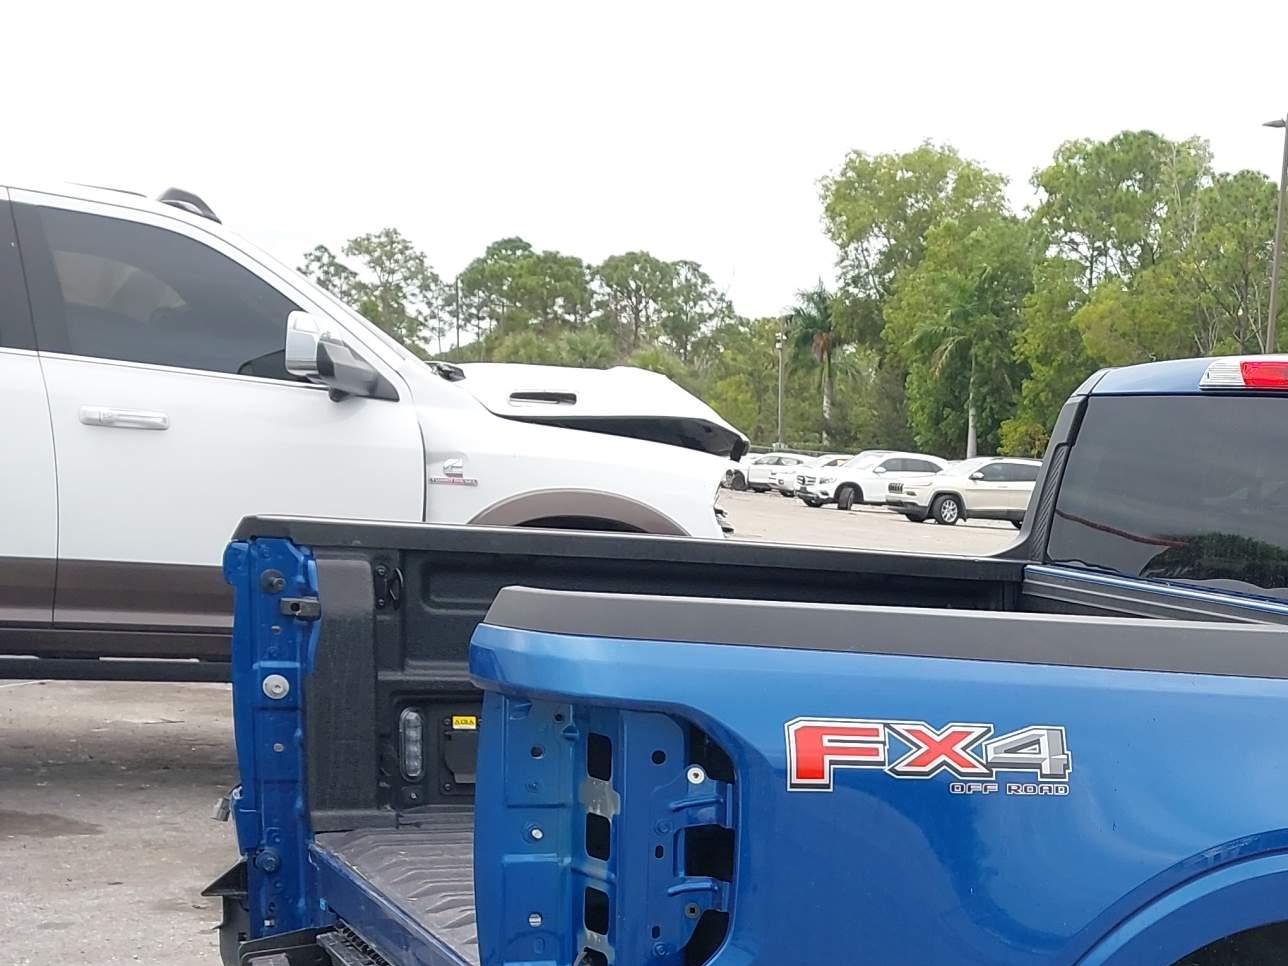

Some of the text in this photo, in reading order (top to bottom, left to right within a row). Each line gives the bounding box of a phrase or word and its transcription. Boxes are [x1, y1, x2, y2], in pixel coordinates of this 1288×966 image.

[785, 716, 1072, 792] FX4
[949, 782, 1070, 796] OFF ROAD
